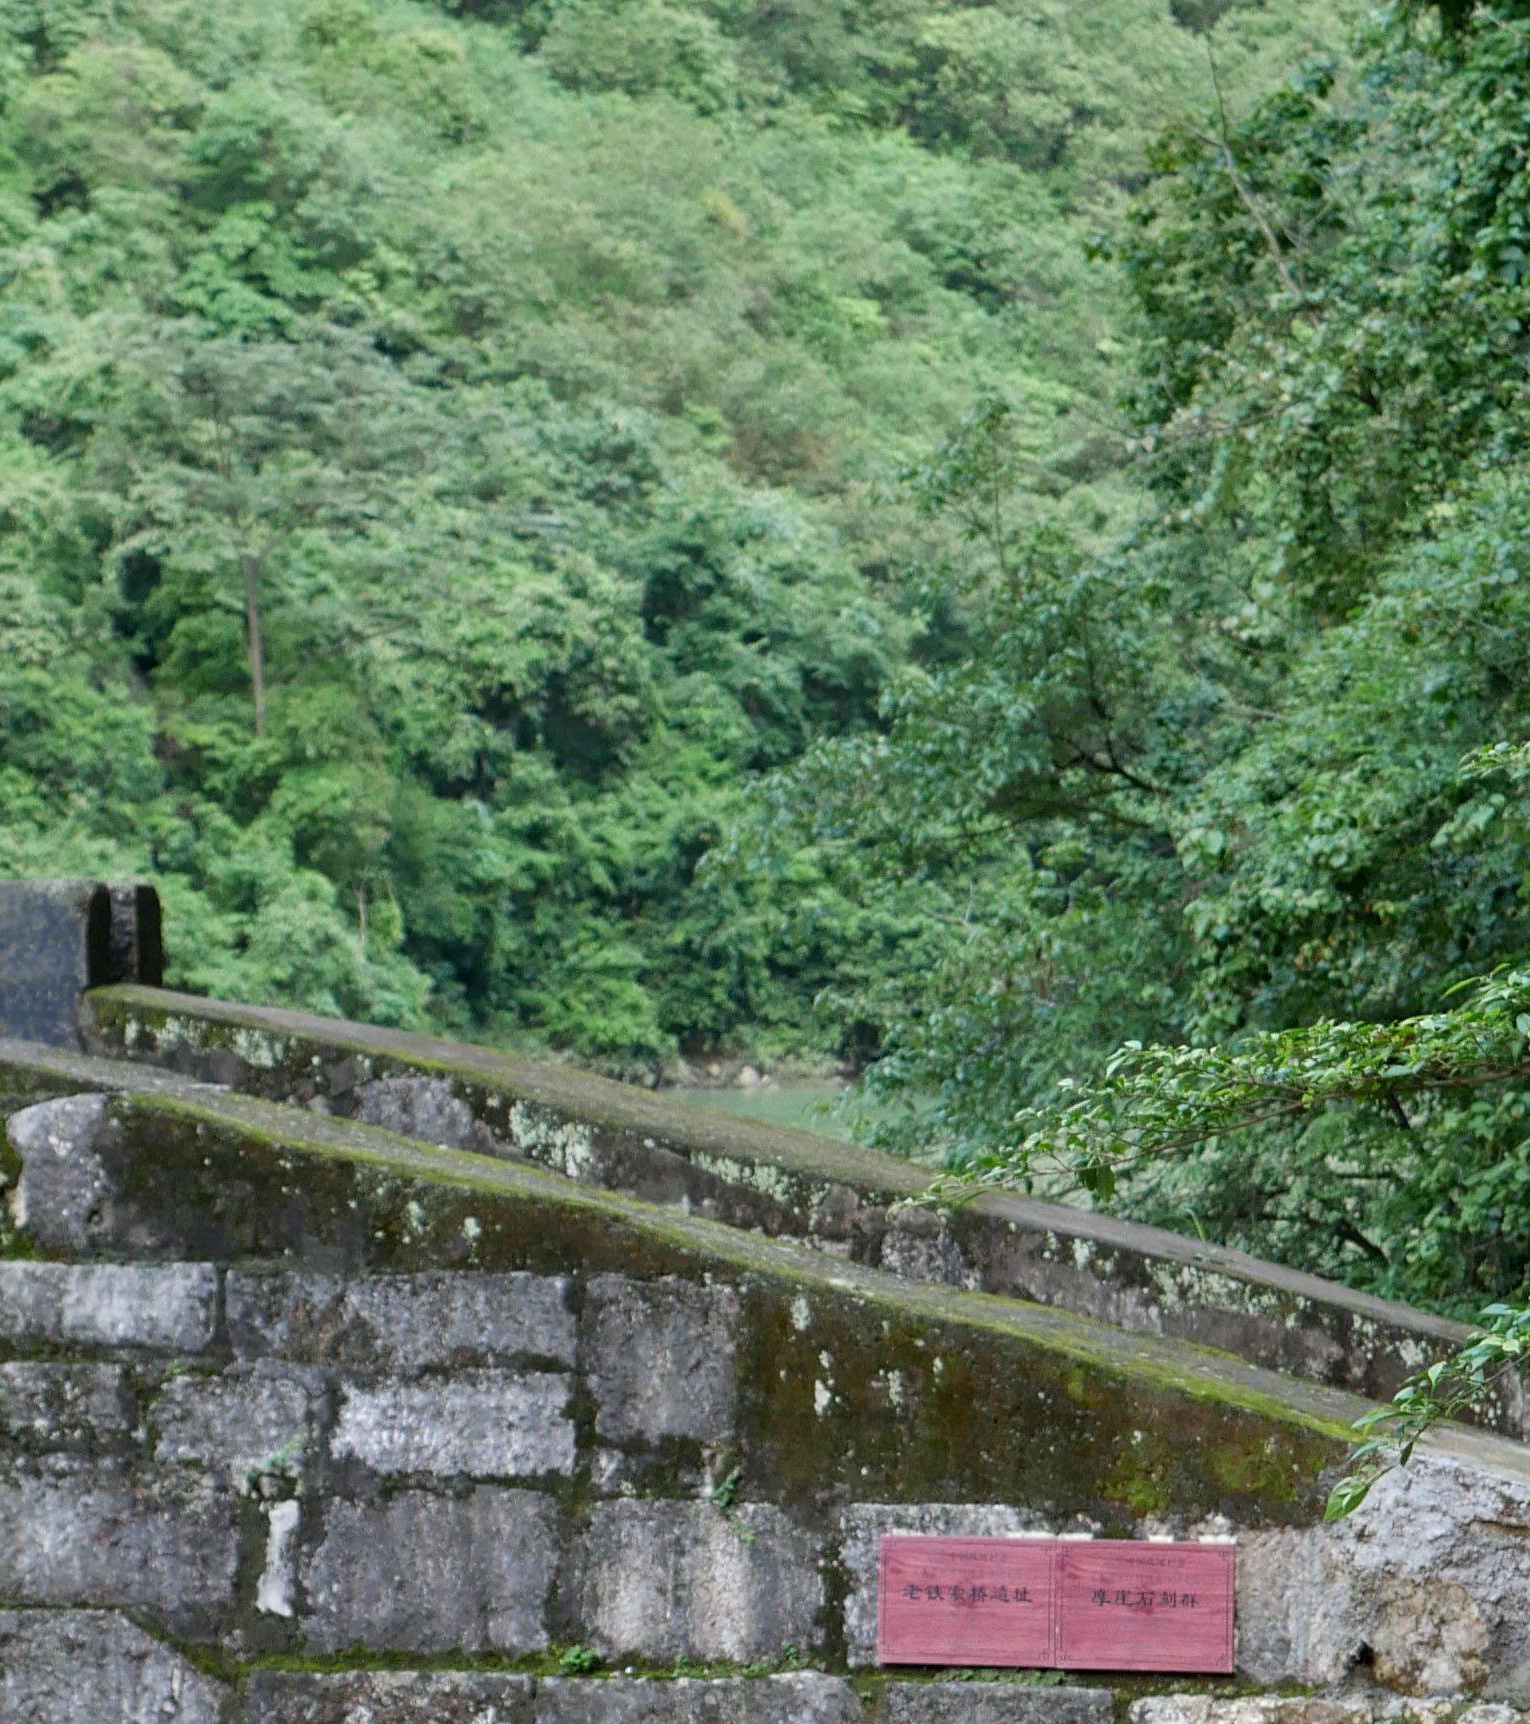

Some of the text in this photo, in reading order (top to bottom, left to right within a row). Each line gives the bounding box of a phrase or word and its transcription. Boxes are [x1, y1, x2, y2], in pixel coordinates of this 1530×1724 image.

[1091, 1588, 1200, 1609] 摩崖石刻群
